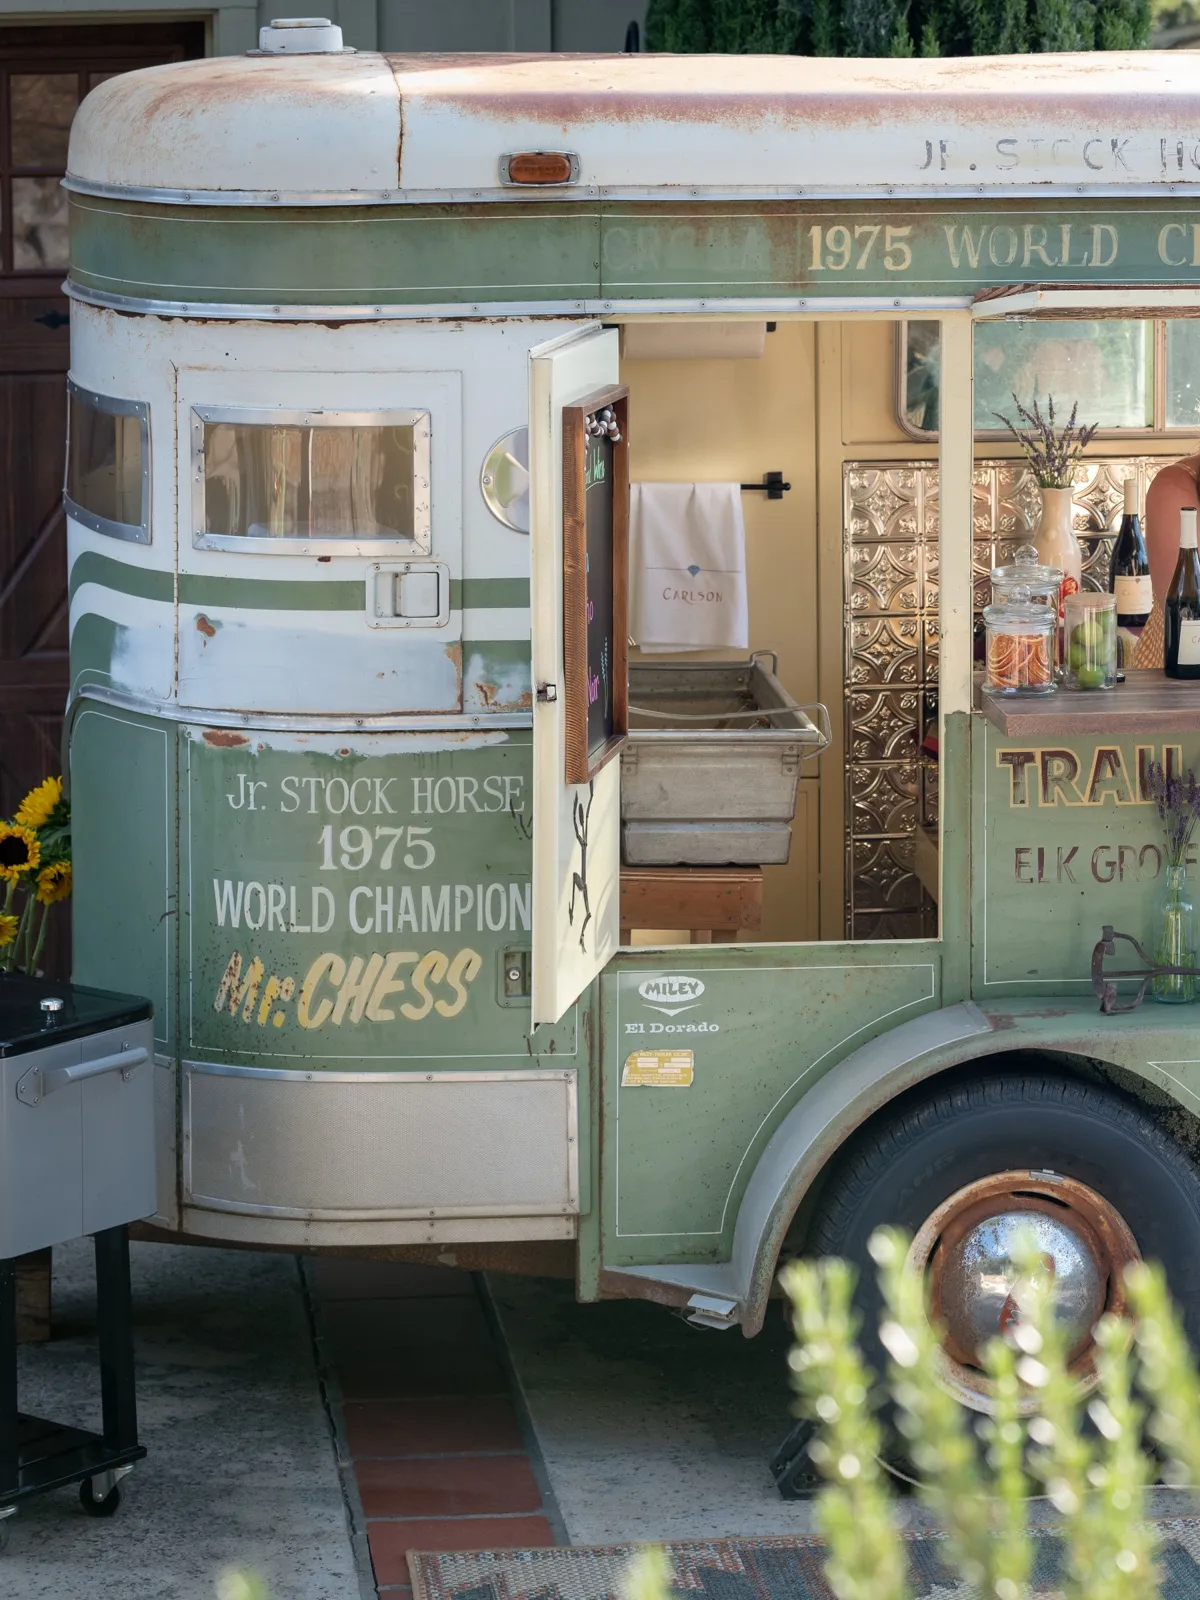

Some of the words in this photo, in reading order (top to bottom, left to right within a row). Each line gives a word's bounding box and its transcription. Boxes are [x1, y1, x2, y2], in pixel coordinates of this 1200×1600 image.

[807, 224, 913, 271] 1975
[943, 223, 1119, 269] WORLD
[662, 587, 723, 605] CARLSON
[226, 773, 267, 812] Jr.
[279, 776, 399, 815] STOCK
[410, 775, 525, 814] HORSE
[317, 824, 436, 872] 1975
[1013, 845, 1080, 884] ELK
[213, 878, 336, 934] WORLD
[349, 882, 532, 934] CHAMPION
[296, 947, 483, 1031] CHESS
[644, 981, 700, 997] MILEY
[624, 1022, 646, 1034] El
[649, 1021, 720, 1034] Dorado
